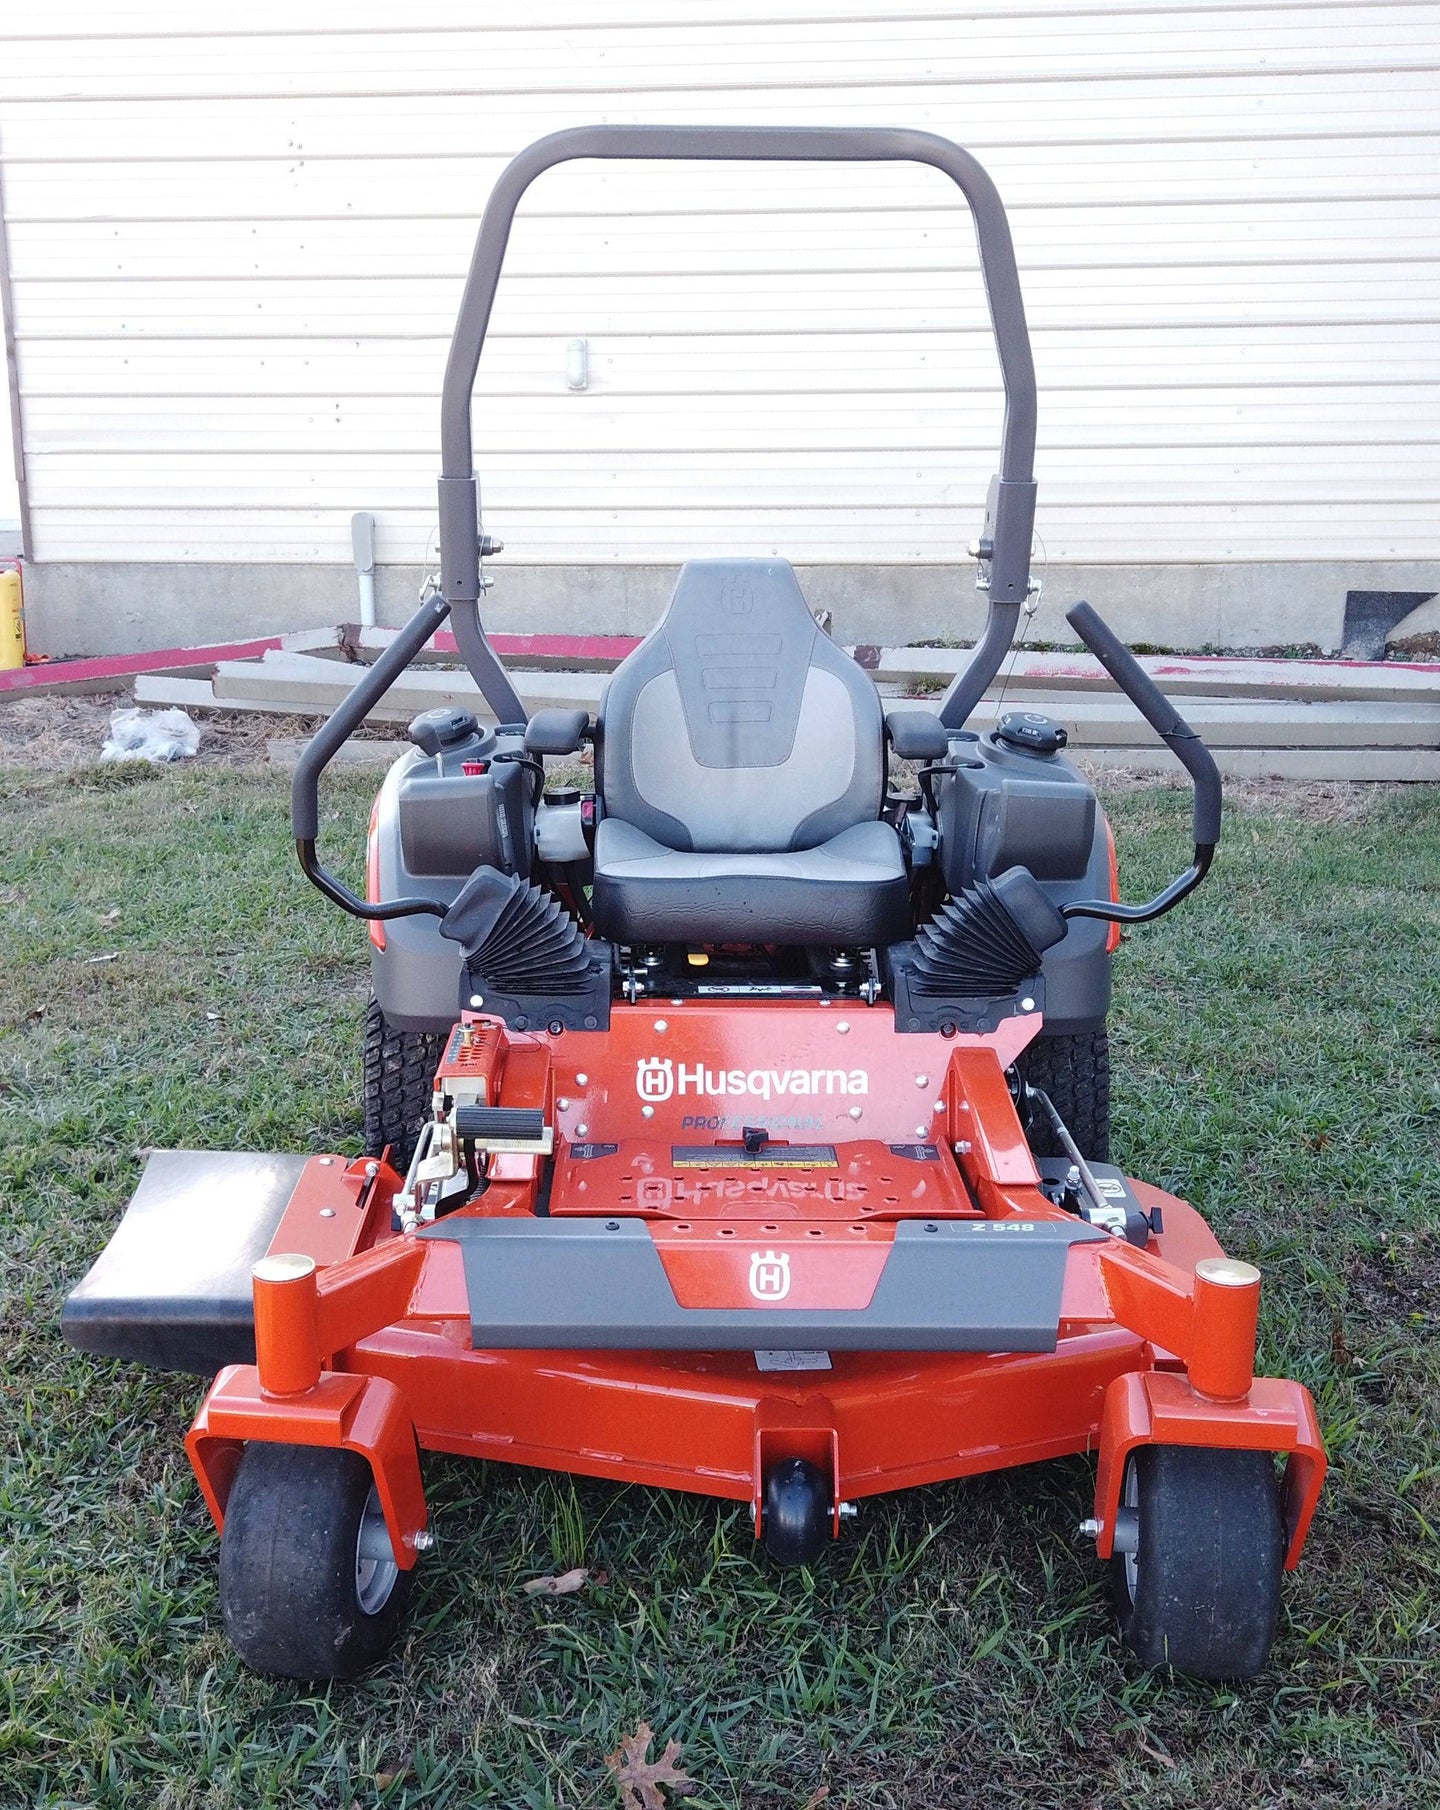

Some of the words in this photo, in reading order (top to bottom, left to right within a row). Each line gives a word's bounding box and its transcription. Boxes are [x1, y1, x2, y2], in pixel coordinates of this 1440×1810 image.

[677, 1063, 868, 1100] Husqvarna
[971, 1223, 986, 1231] Z
[992, 1223, 1035, 1232] 548
